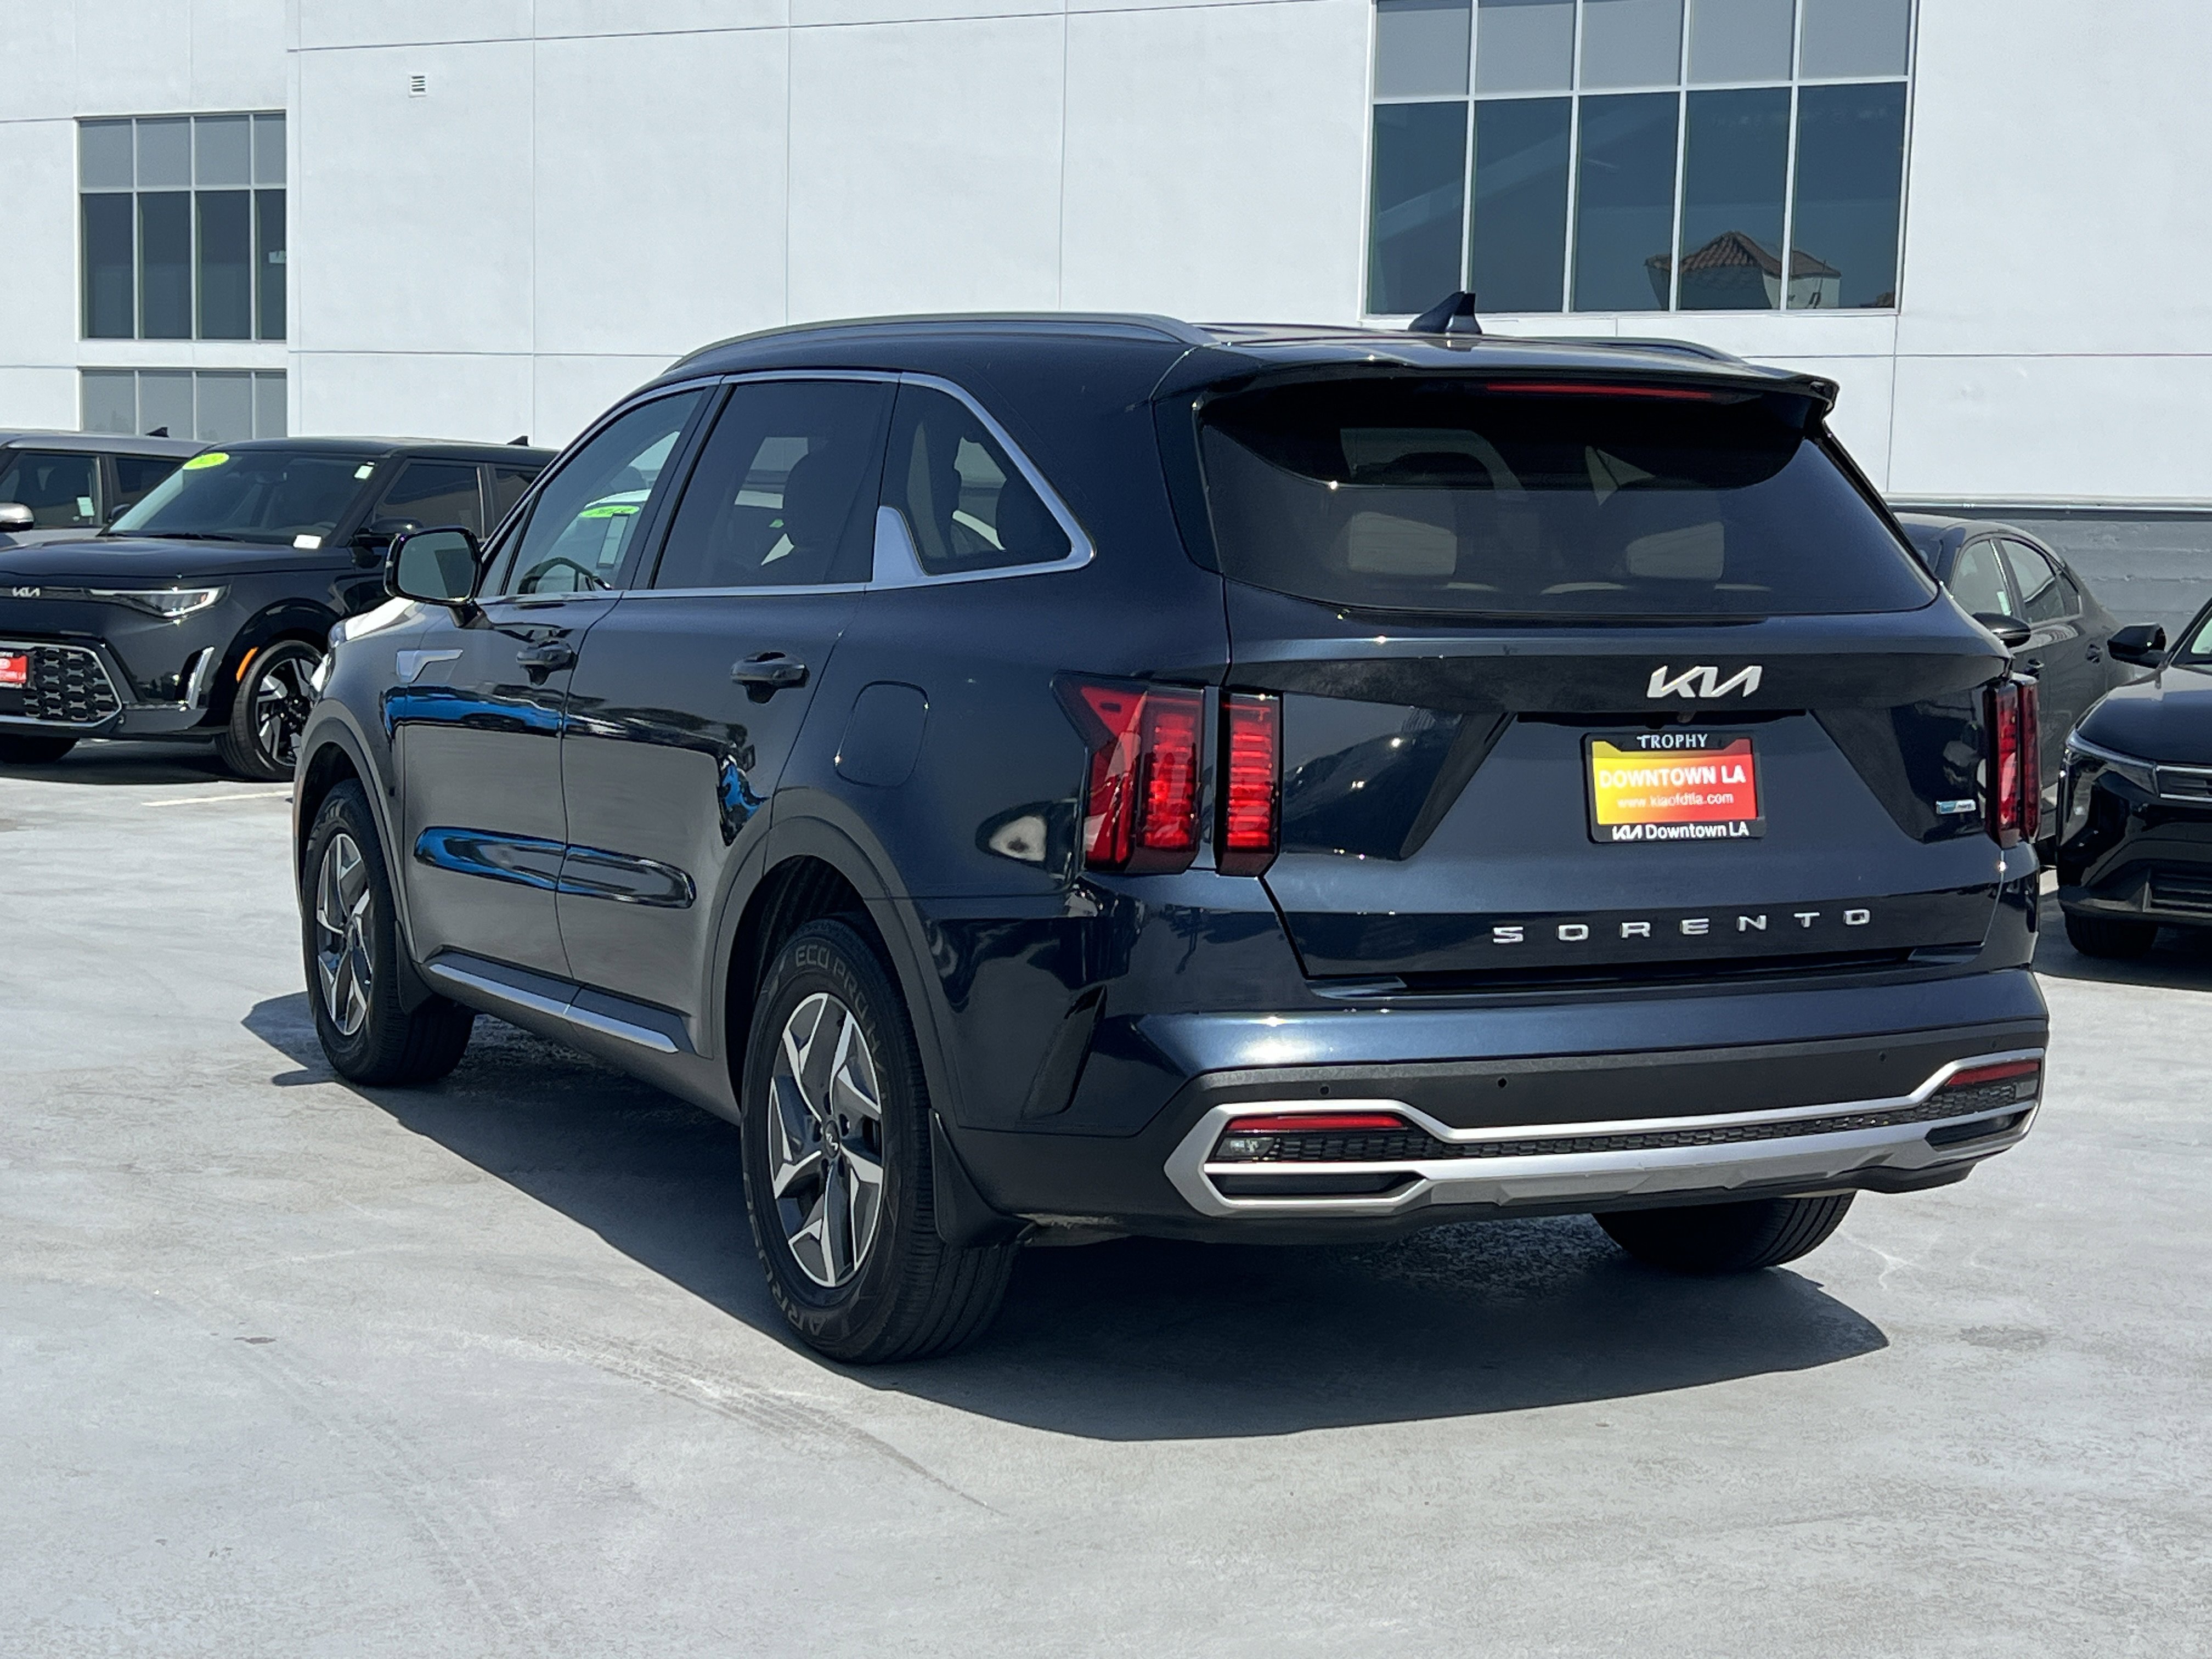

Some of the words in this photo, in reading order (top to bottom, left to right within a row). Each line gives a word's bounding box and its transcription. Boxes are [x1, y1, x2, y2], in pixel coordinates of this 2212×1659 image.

[12, 586, 41, 597] KIA
[1647, 665, 1762, 698] KIA
[1637, 733, 1708, 749] TROPHY
[1599, 766, 1717, 788] DOWNTOWN
[1721, 764, 1746, 783] LA
[1612, 826, 1642, 840] KIA
[1645, 824, 1726, 839] Downtown
[1729, 821, 1750, 837] LA
[1493, 909, 1870, 943] SORENTO
[796, 945, 830, 970] ECO
